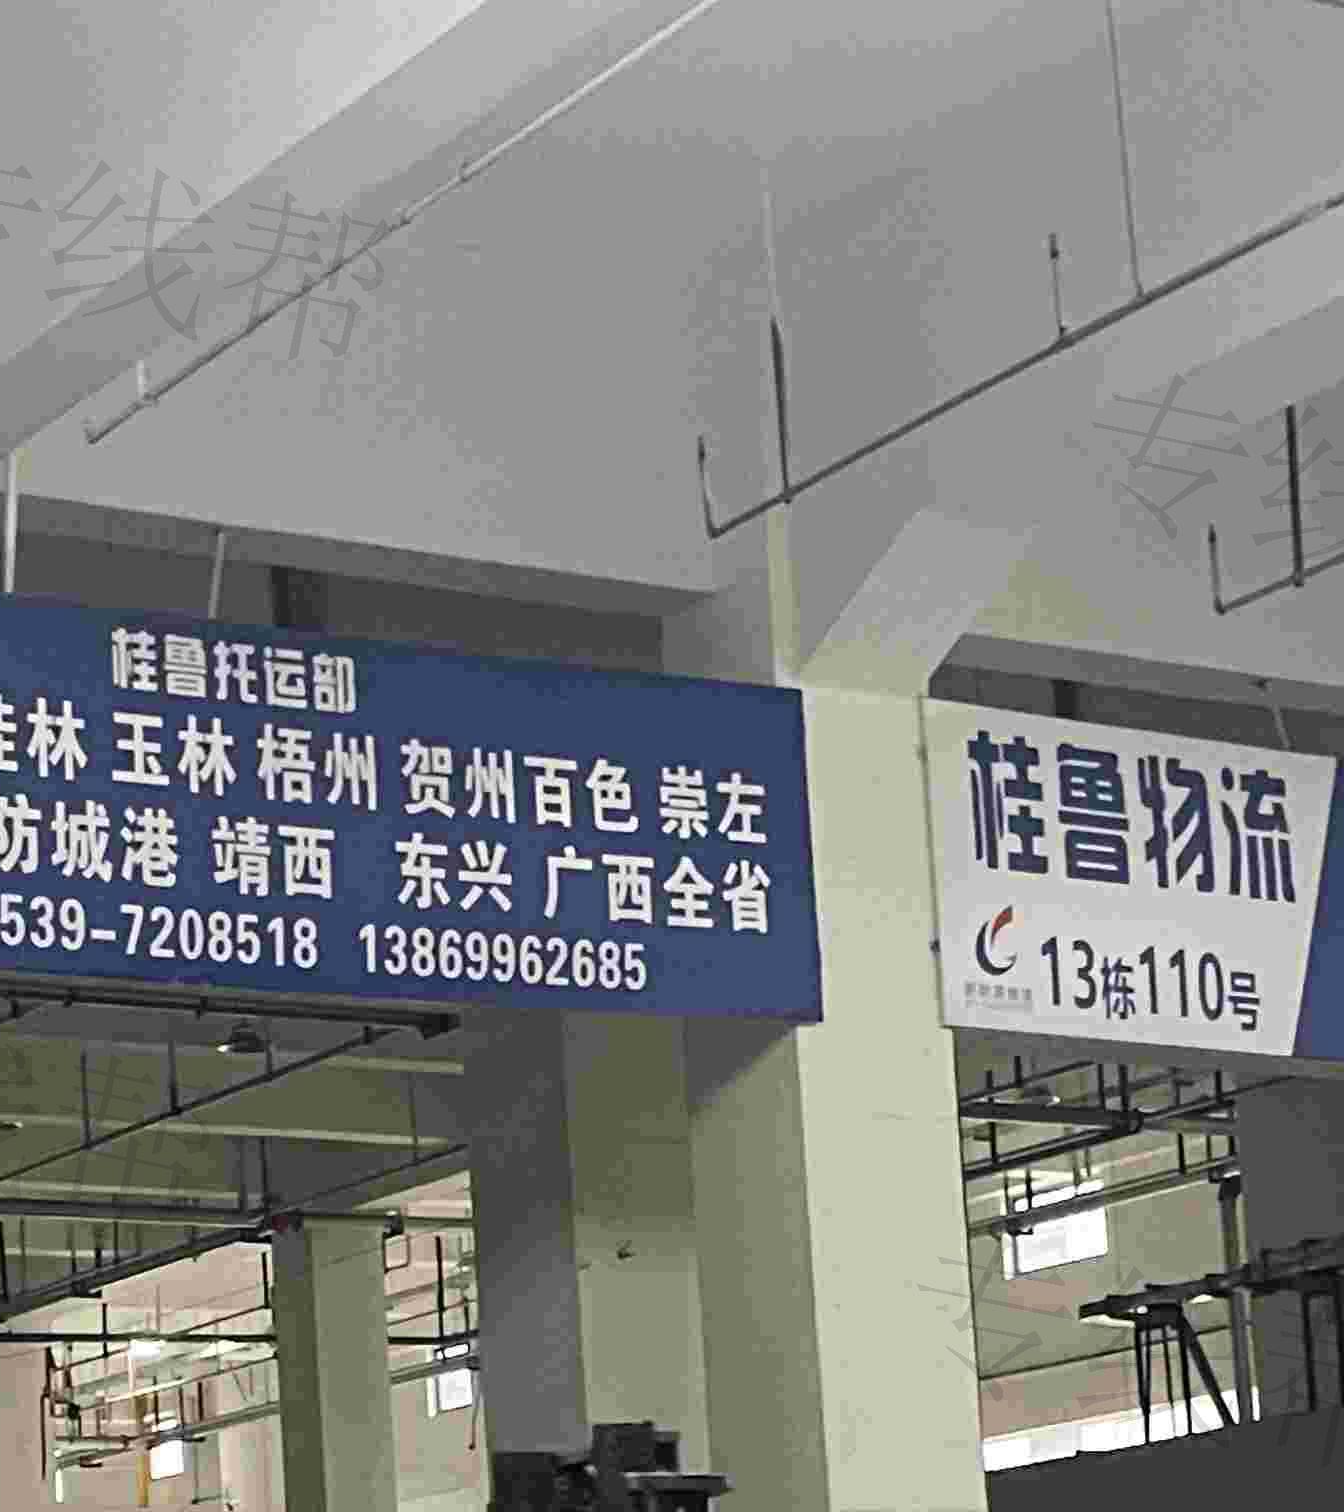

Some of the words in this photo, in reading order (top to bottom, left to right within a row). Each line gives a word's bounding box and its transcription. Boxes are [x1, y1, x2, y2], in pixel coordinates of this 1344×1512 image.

[111, 625, 356, 714] 桂鲁托运部
[111, 710, 236, 797] 玉林
[257, 721, 377, 810] 梧州
[658, 765, 767, 843] 崇左
[967, 729, 1296, 903] 桂鲁物流
[212, 815, 335, 900] 靖西
[397, 831, 512, 913] 东兴
[544, 846, 769, 934] 广西全省
[359, 924, 646, 991] 13869962685
[1041, 936, 1260, 1031] 13栋110号
